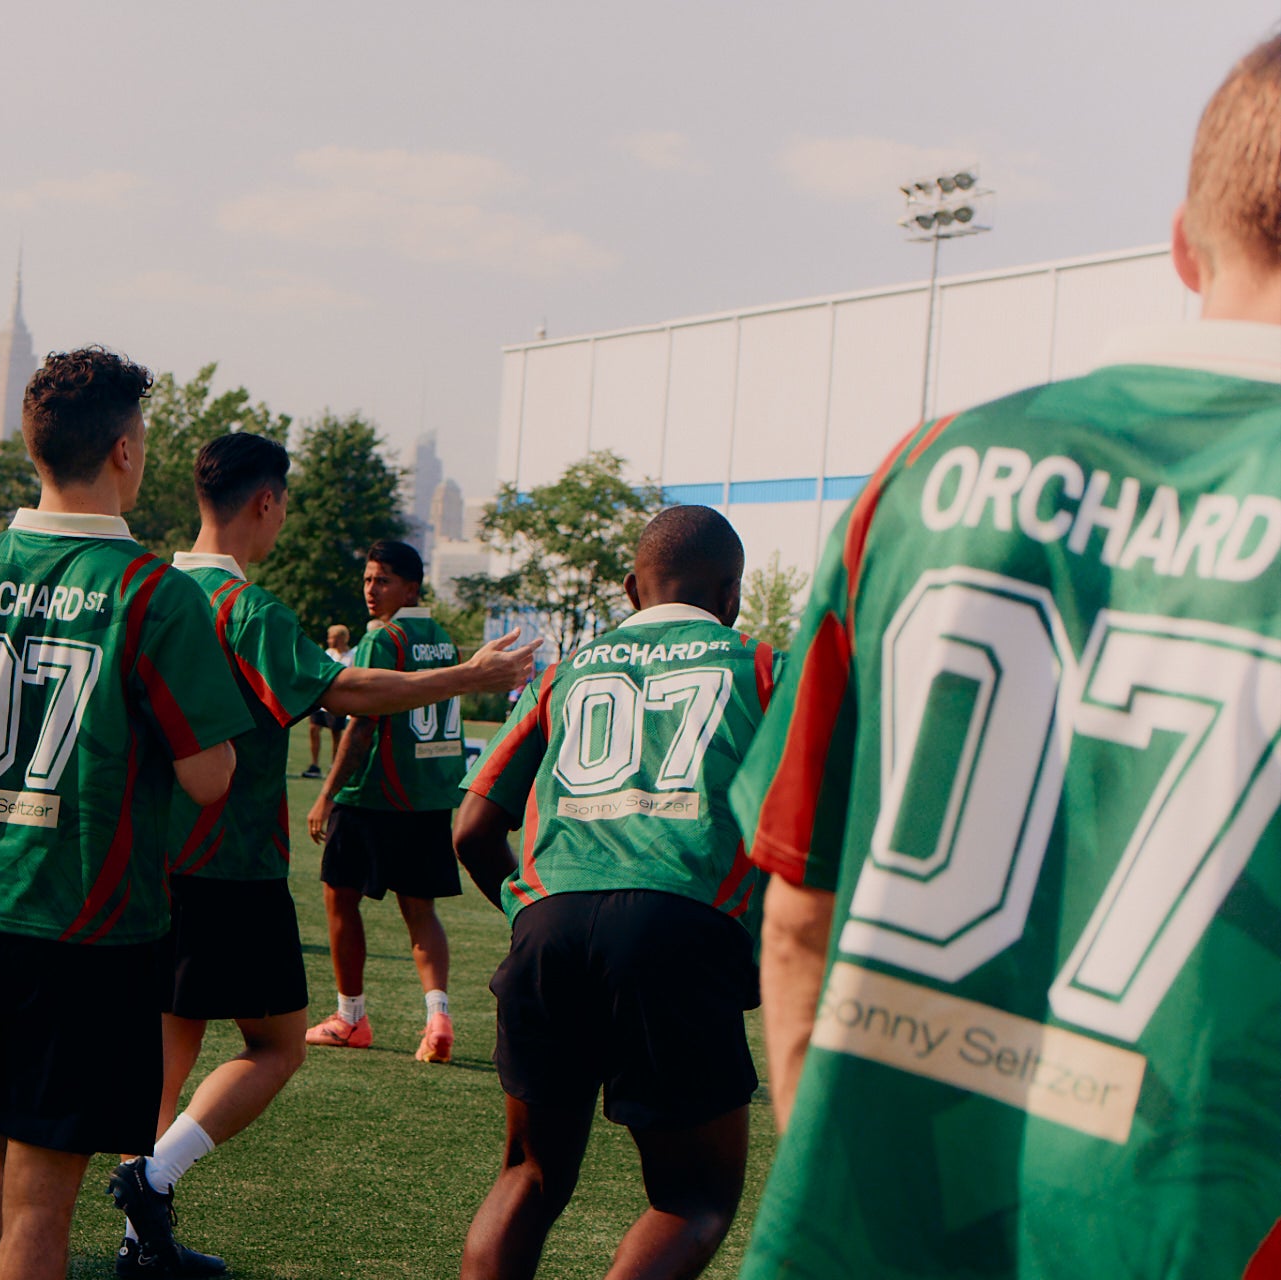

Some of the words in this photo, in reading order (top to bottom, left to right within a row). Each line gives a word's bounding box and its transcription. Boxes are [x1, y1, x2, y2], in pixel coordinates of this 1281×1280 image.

[921, 447, 1281, 582] ORCHARD
[573, 641, 707, 669] ORCHARD
[553, 667, 733, 795] 07
[565, 799, 622, 816] Sonny
[839, 566, 1281, 1044] 07
[957, 1024, 1122, 1108] Seltzer
